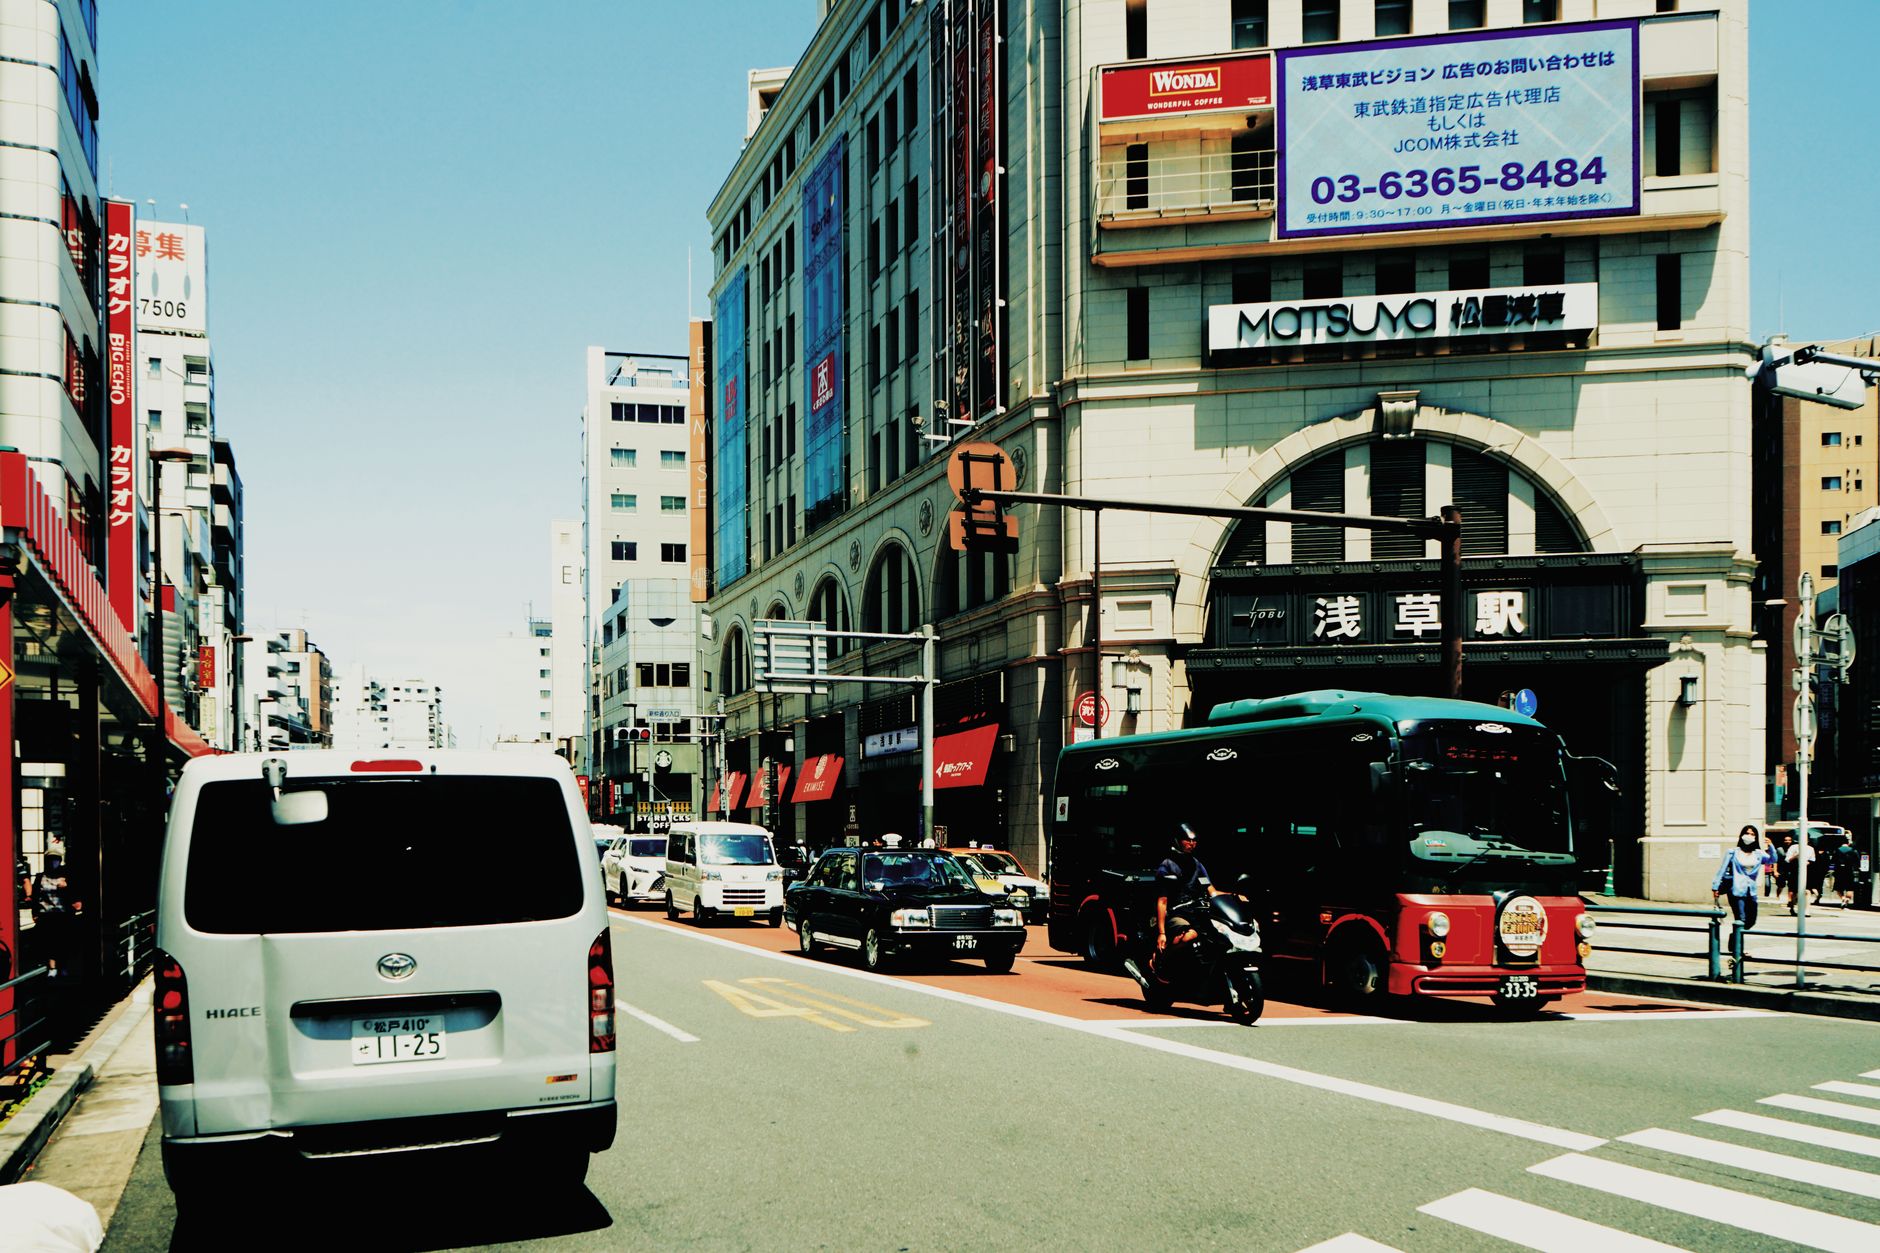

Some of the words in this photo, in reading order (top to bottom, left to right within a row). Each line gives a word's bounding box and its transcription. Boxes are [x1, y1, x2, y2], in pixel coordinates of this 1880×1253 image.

[1153, 70, 1216, 92] WONDA
[1302, 68, 1436, 92] 浅草東武ビジョン
[1442, 50, 1616, 80] 広告のお問い合わせは
[1147, 101, 1192, 110] WONDERFUL
[1194, 97, 1223, 106] COFFEE
[1353, 86, 1562, 119] 東武鉄道指定広告代理店
[1427, 112, 1487, 132] もしくは
[1393, 130, 1520, 154] JCOM株式会社
[1310, 156, 1607, 205] 03-6365-8484
[108, 233, 131, 315] カラオケ
[109, 333, 125, 362] BIG
[109, 363, 126, 405] ECHO
[692, 346, 712, 507] EKIMISE
[110, 444, 133, 527] カラオケ
[1314, 591, 1525, 638] 浅草駅
[1504, 982, 1538, 998] 33-35
[206, 1007, 262, 1020] HIACE
[373, 1018, 425, 1034] 松戸410
[378, 1033, 441, 1059] 11-25
